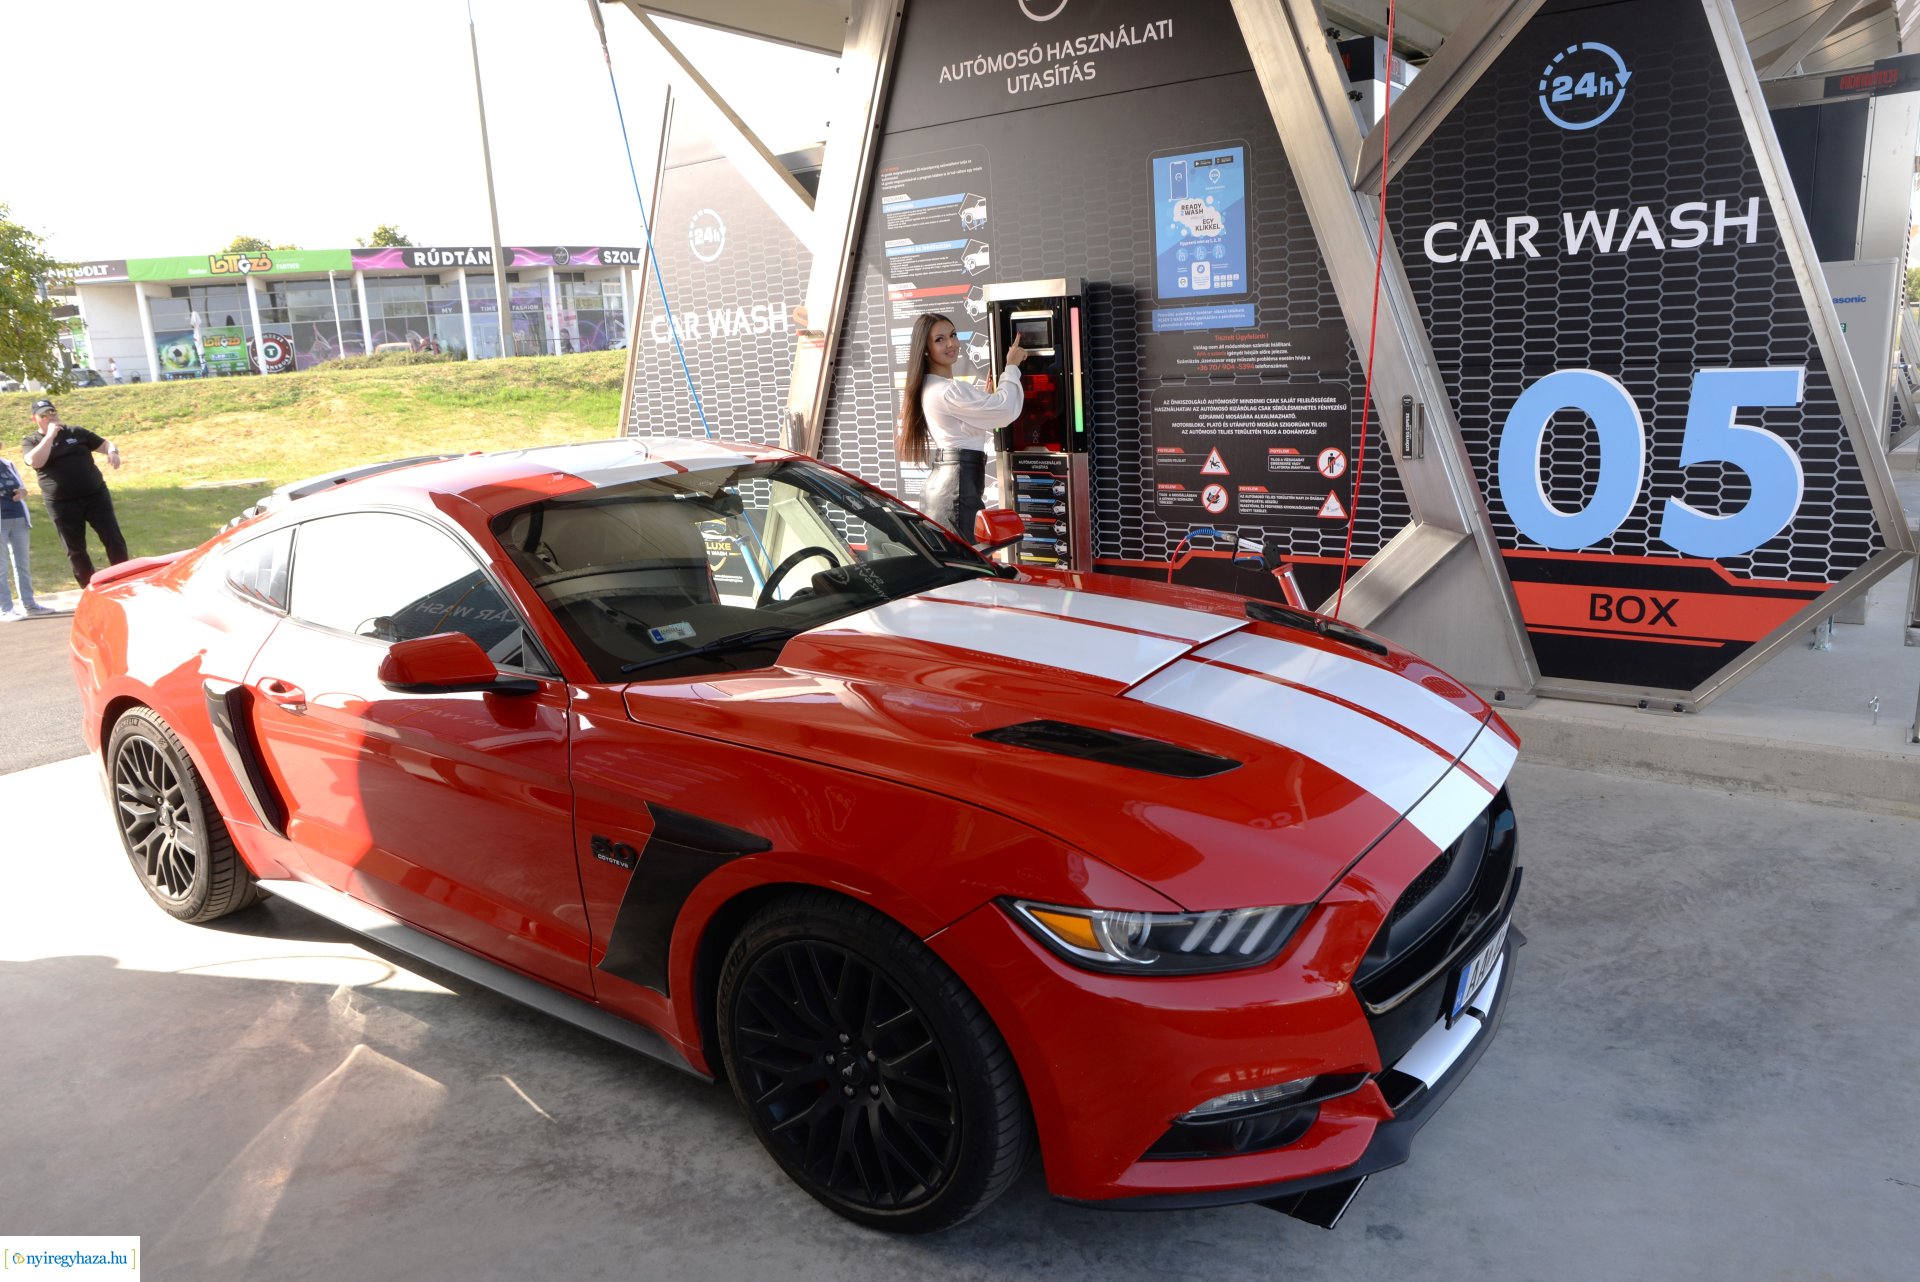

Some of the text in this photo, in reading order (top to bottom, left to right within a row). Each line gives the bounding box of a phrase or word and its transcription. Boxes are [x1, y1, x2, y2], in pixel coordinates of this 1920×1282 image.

[939, 19, 1174, 83] AUTÓMOSÓ HASZNÁLATI
[1006, 62, 1096, 94] UTASÍTÁS
[1552, 71, 1614, 102] 24h
[694, 227, 721, 246] 24h
[1424, 197, 1759, 263] CAR WASH
[414, 248, 492, 266] RÚDTÁN
[1833, 295, 1866, 303] asonic
[650, 302, 788, 344] CAR WASH
[1497, 366, 1806, 558] 05
[705, 542, 731, 550] LUXE
[1589, 593, 1680, 627] BOX
